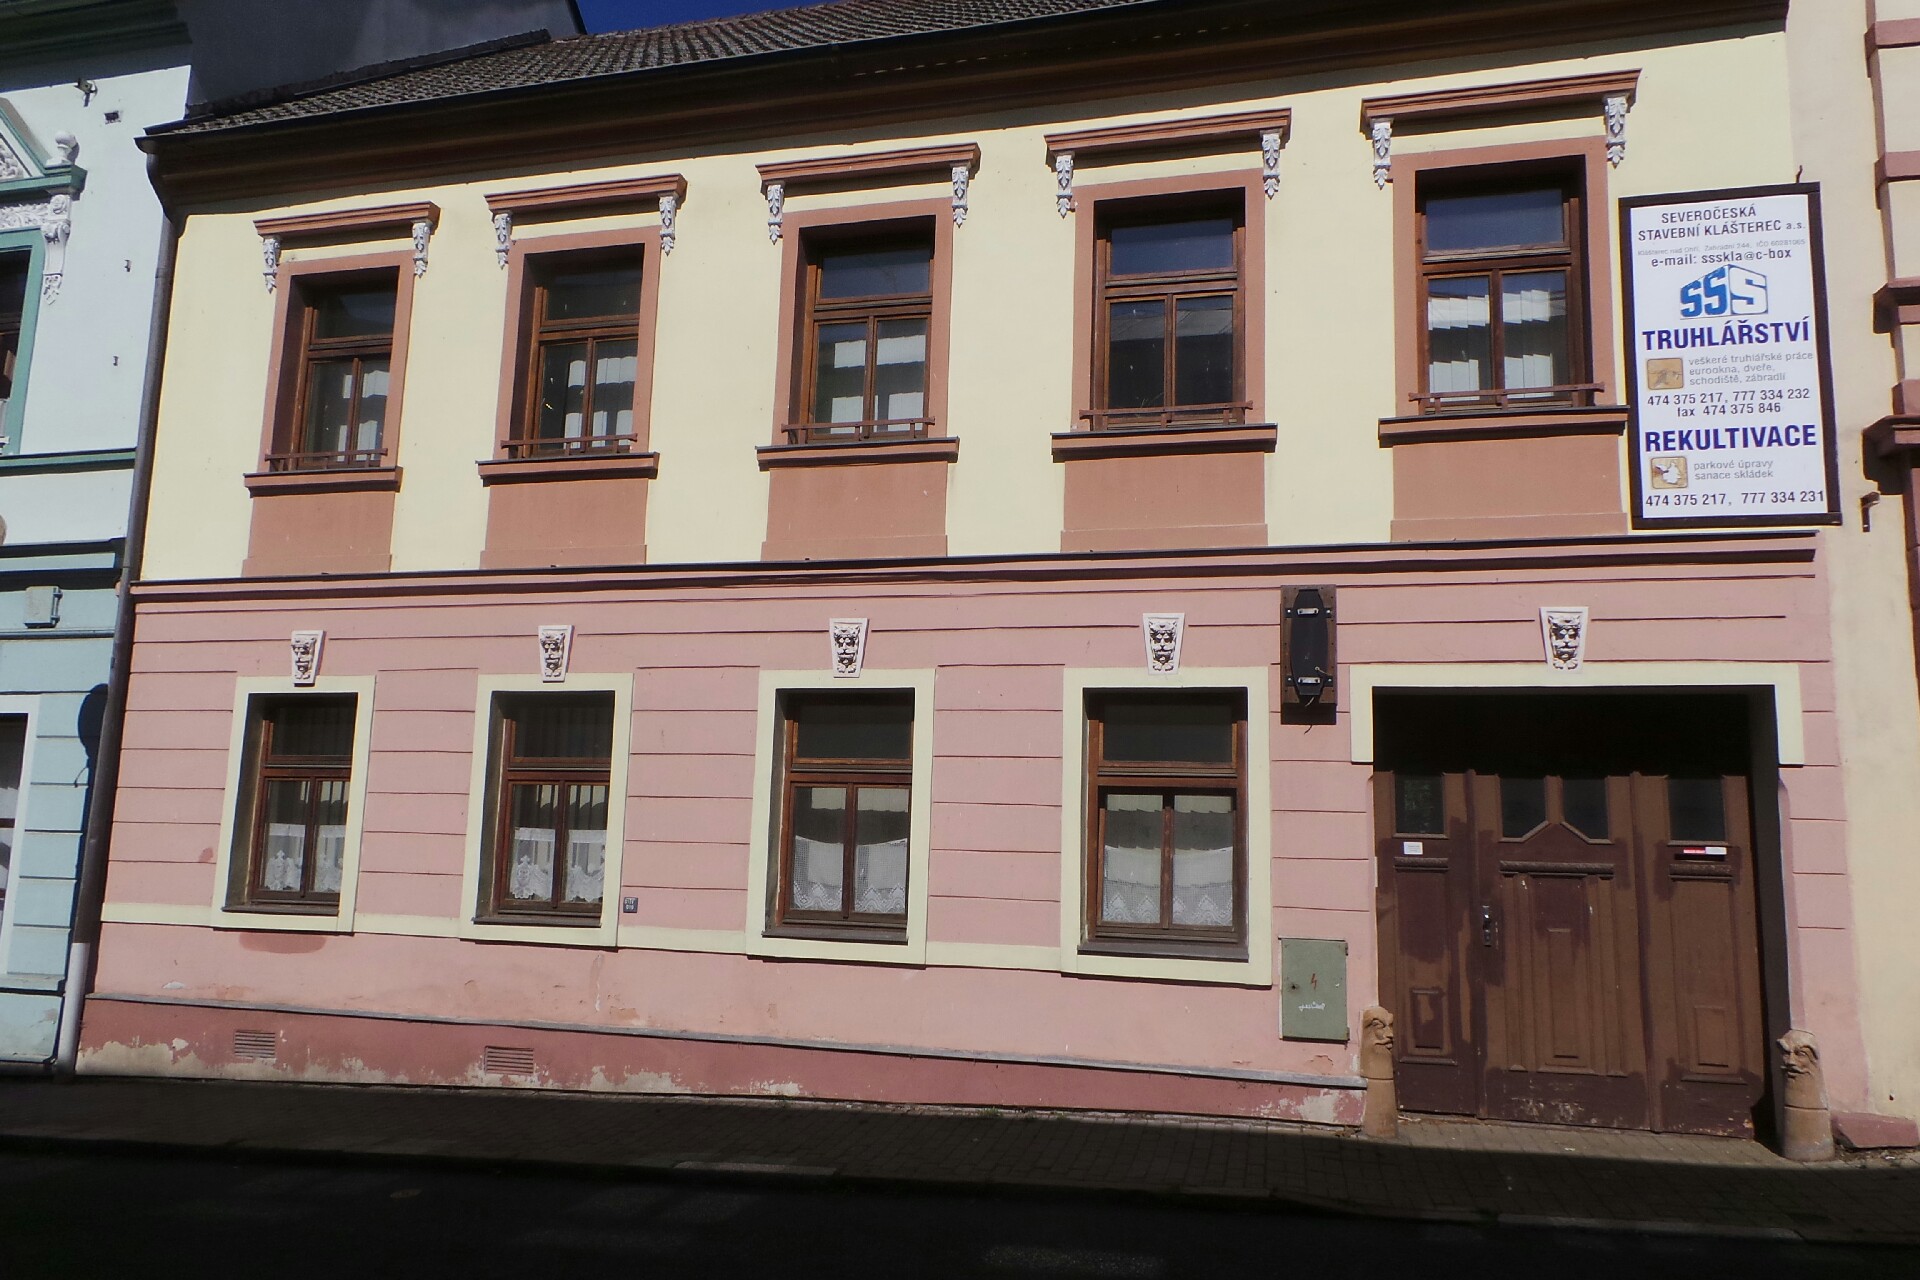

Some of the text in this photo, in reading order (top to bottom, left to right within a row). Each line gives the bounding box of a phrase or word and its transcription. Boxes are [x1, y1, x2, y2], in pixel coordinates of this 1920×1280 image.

[1661, 203, 1757, 224] SEVEROČESKÁ
[1638, 219, 1806, 241] STAVEBNÍ KLÁŠTEREC a.s.
[1651, 248, 1792, 267] e-mail: ssskla@c-box
[1642, 316, 1810, 351] TRUHLÁŘSTVÍ
[1688, 351, 1814, 365] veškeré truhlářské práce
[1689, 363, 1776, 375] eurookna, dveře,
[1689, 372, 1786, 385] schodiště, zábradlí
[1647, 388, 1810, 406] 474 375 217, 777 334 232
[1677, 402, 1781, 417] fax 474 375 846
[1645, 424, 1817, 453] REKULTIVACE
[1693, 459, 1774, 471] parkové úpravy
[1694, 469, 1774, 481] sanace skládek
[1645, 490, 1825, 507] 474 375 217, 777 334 231
